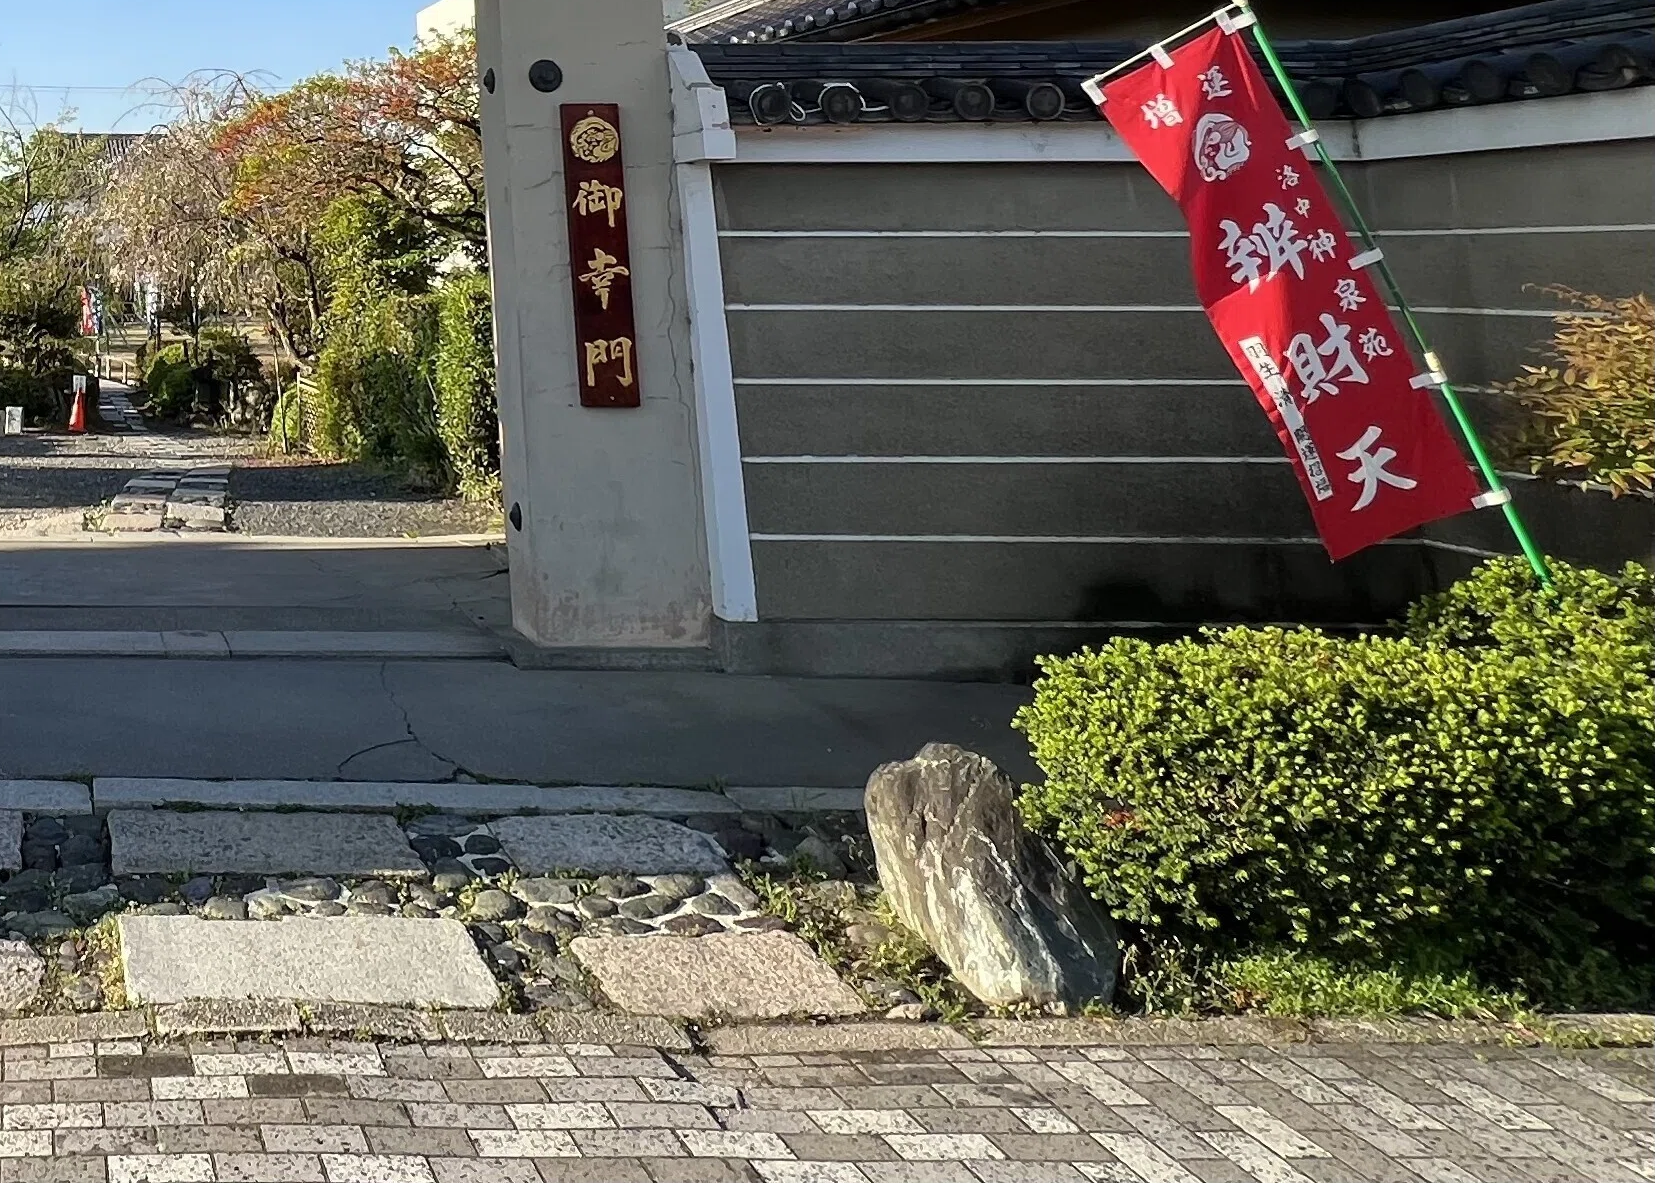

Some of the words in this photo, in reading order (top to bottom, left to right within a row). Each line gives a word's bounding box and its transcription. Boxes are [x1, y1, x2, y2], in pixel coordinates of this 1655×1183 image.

[1140, 65, 1233, 130] 増運
[572, 179, 633, 388] 御幸門
[1275, 164, 1394, 363] 洛中神泉苑
